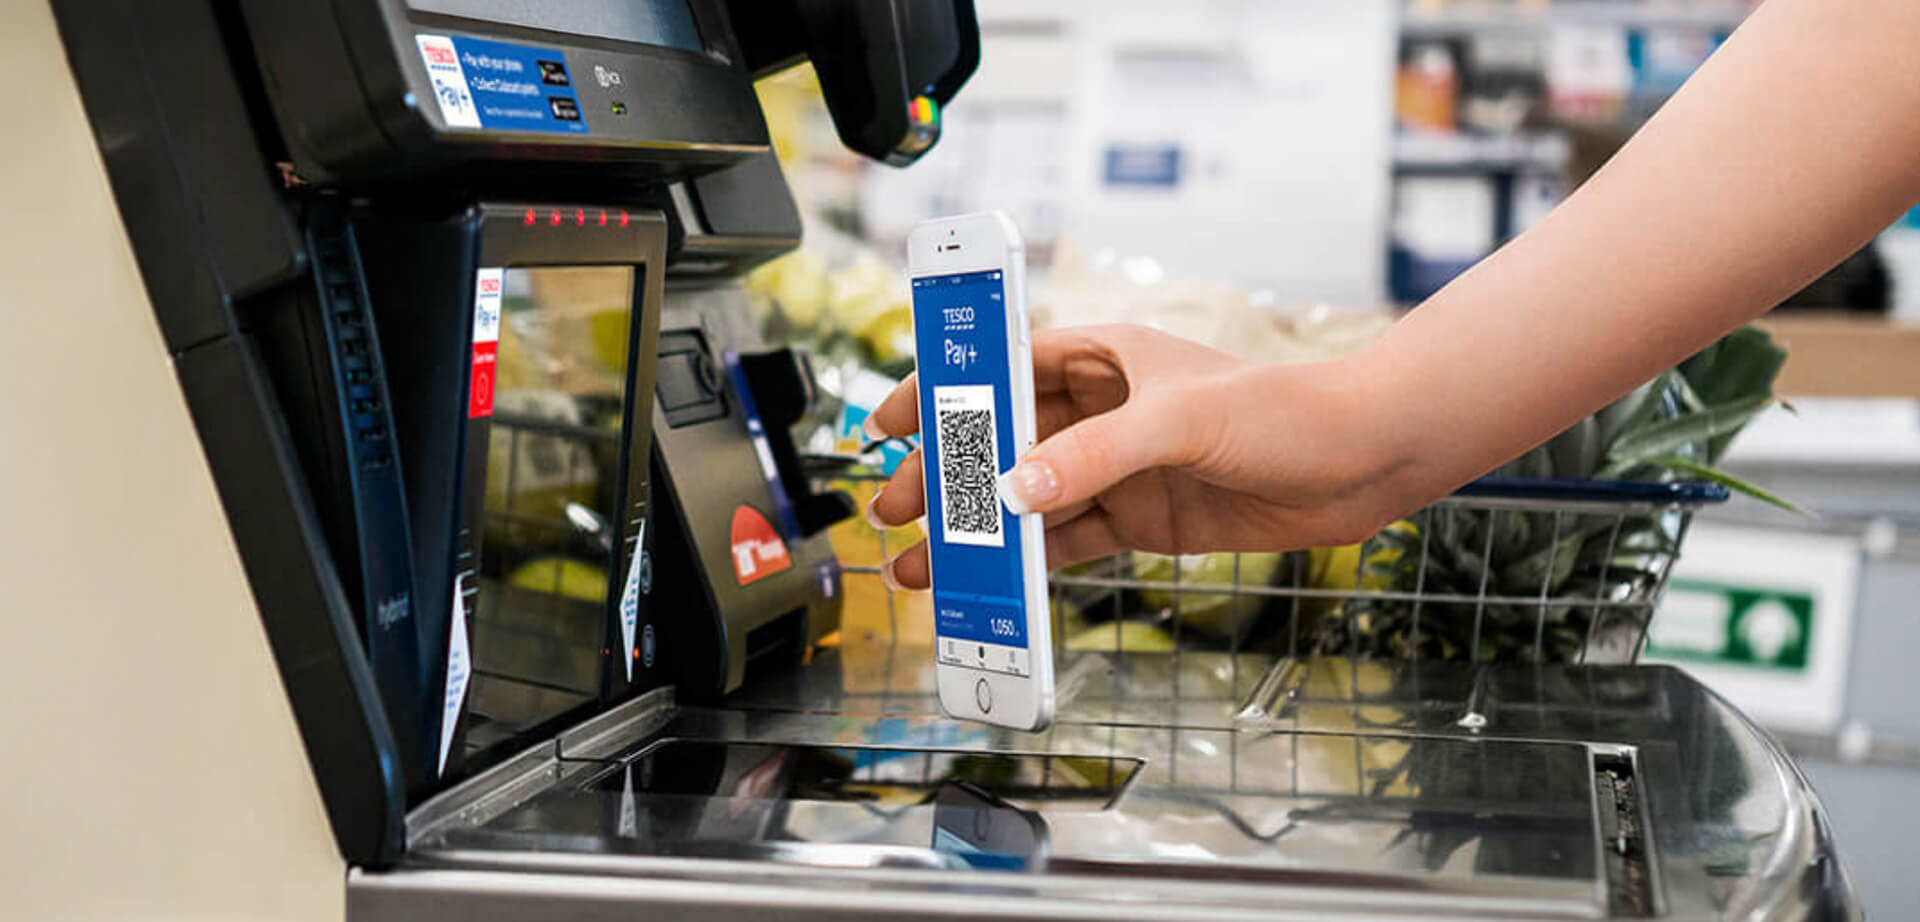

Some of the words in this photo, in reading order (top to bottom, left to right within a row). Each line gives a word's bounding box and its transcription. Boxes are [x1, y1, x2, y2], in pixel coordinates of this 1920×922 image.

[942, 306, 975, 324] TESCO
[943, 338, 978, 373] Pay+
[990, 618, 1016, 637] 1,050
